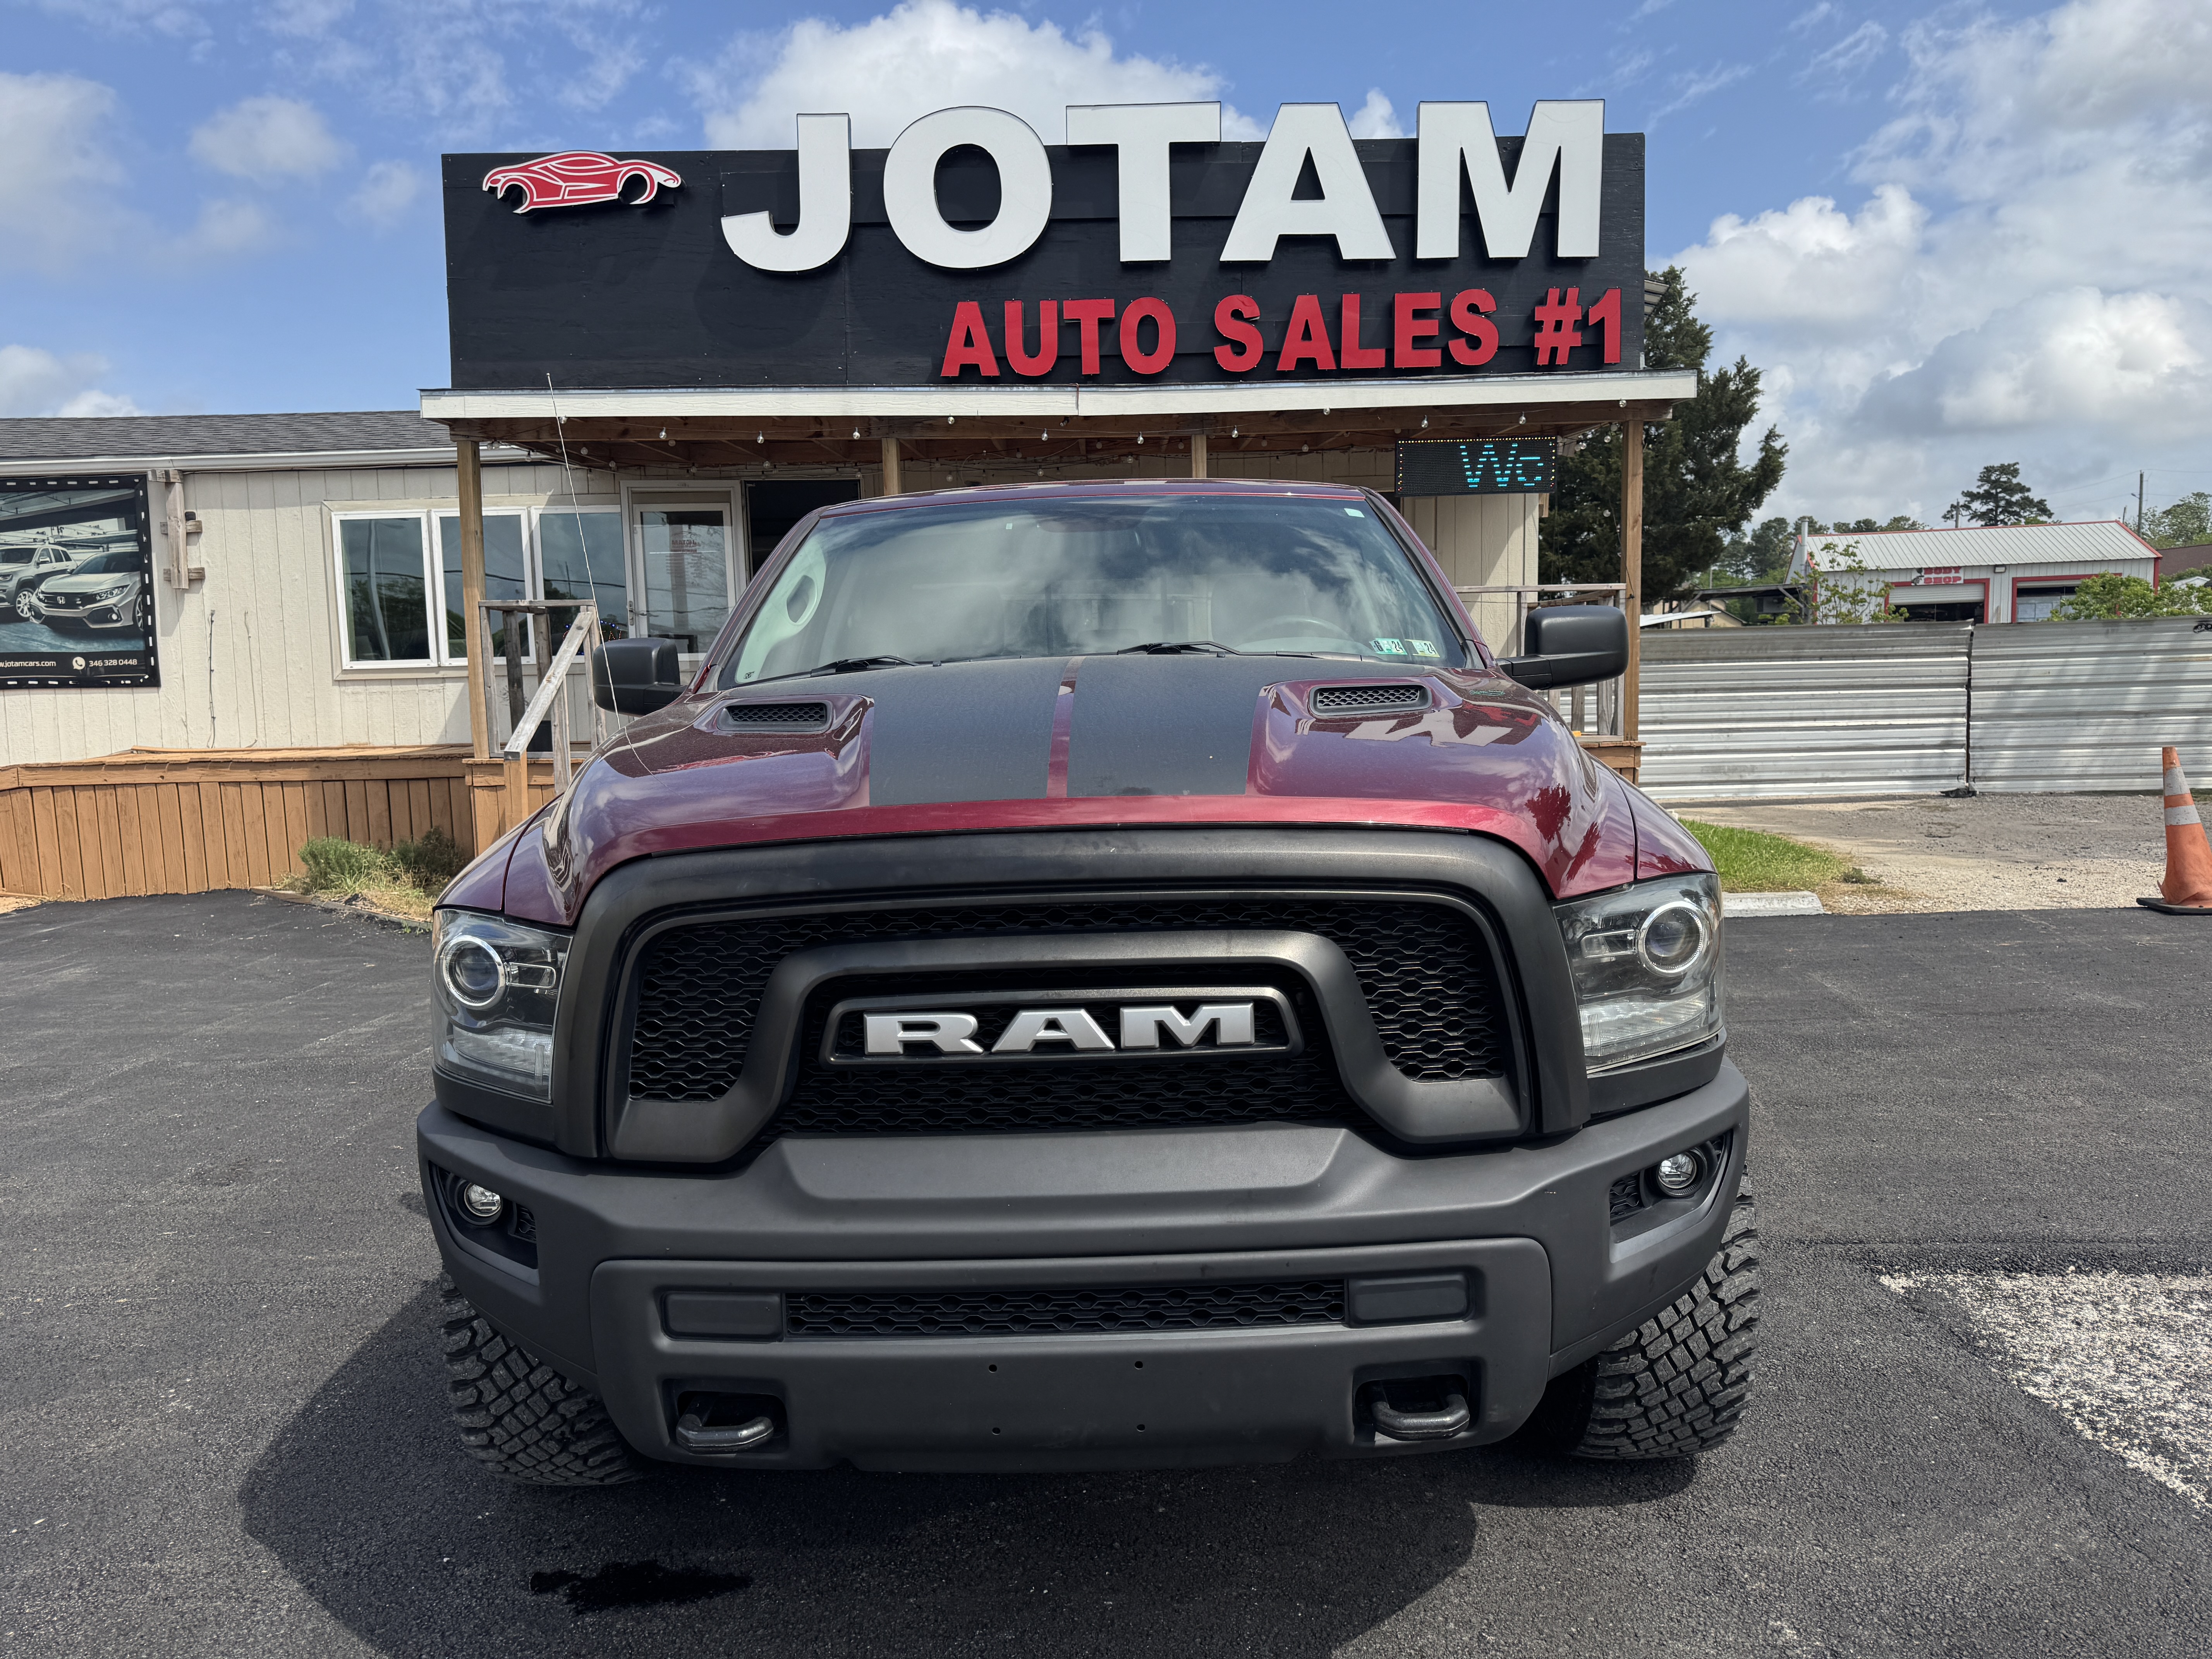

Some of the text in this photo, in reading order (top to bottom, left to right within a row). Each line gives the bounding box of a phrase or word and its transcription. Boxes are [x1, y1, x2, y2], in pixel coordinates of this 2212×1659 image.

[720, 99, 1605, 272] JOTAM
[941, 287, 1622, 376] AUTO SALES #1
[1391, 641, 1403, 651] 24
[1424, 643, 1436, 654] 24
[864, 1002, 1255, 1054] RAM
